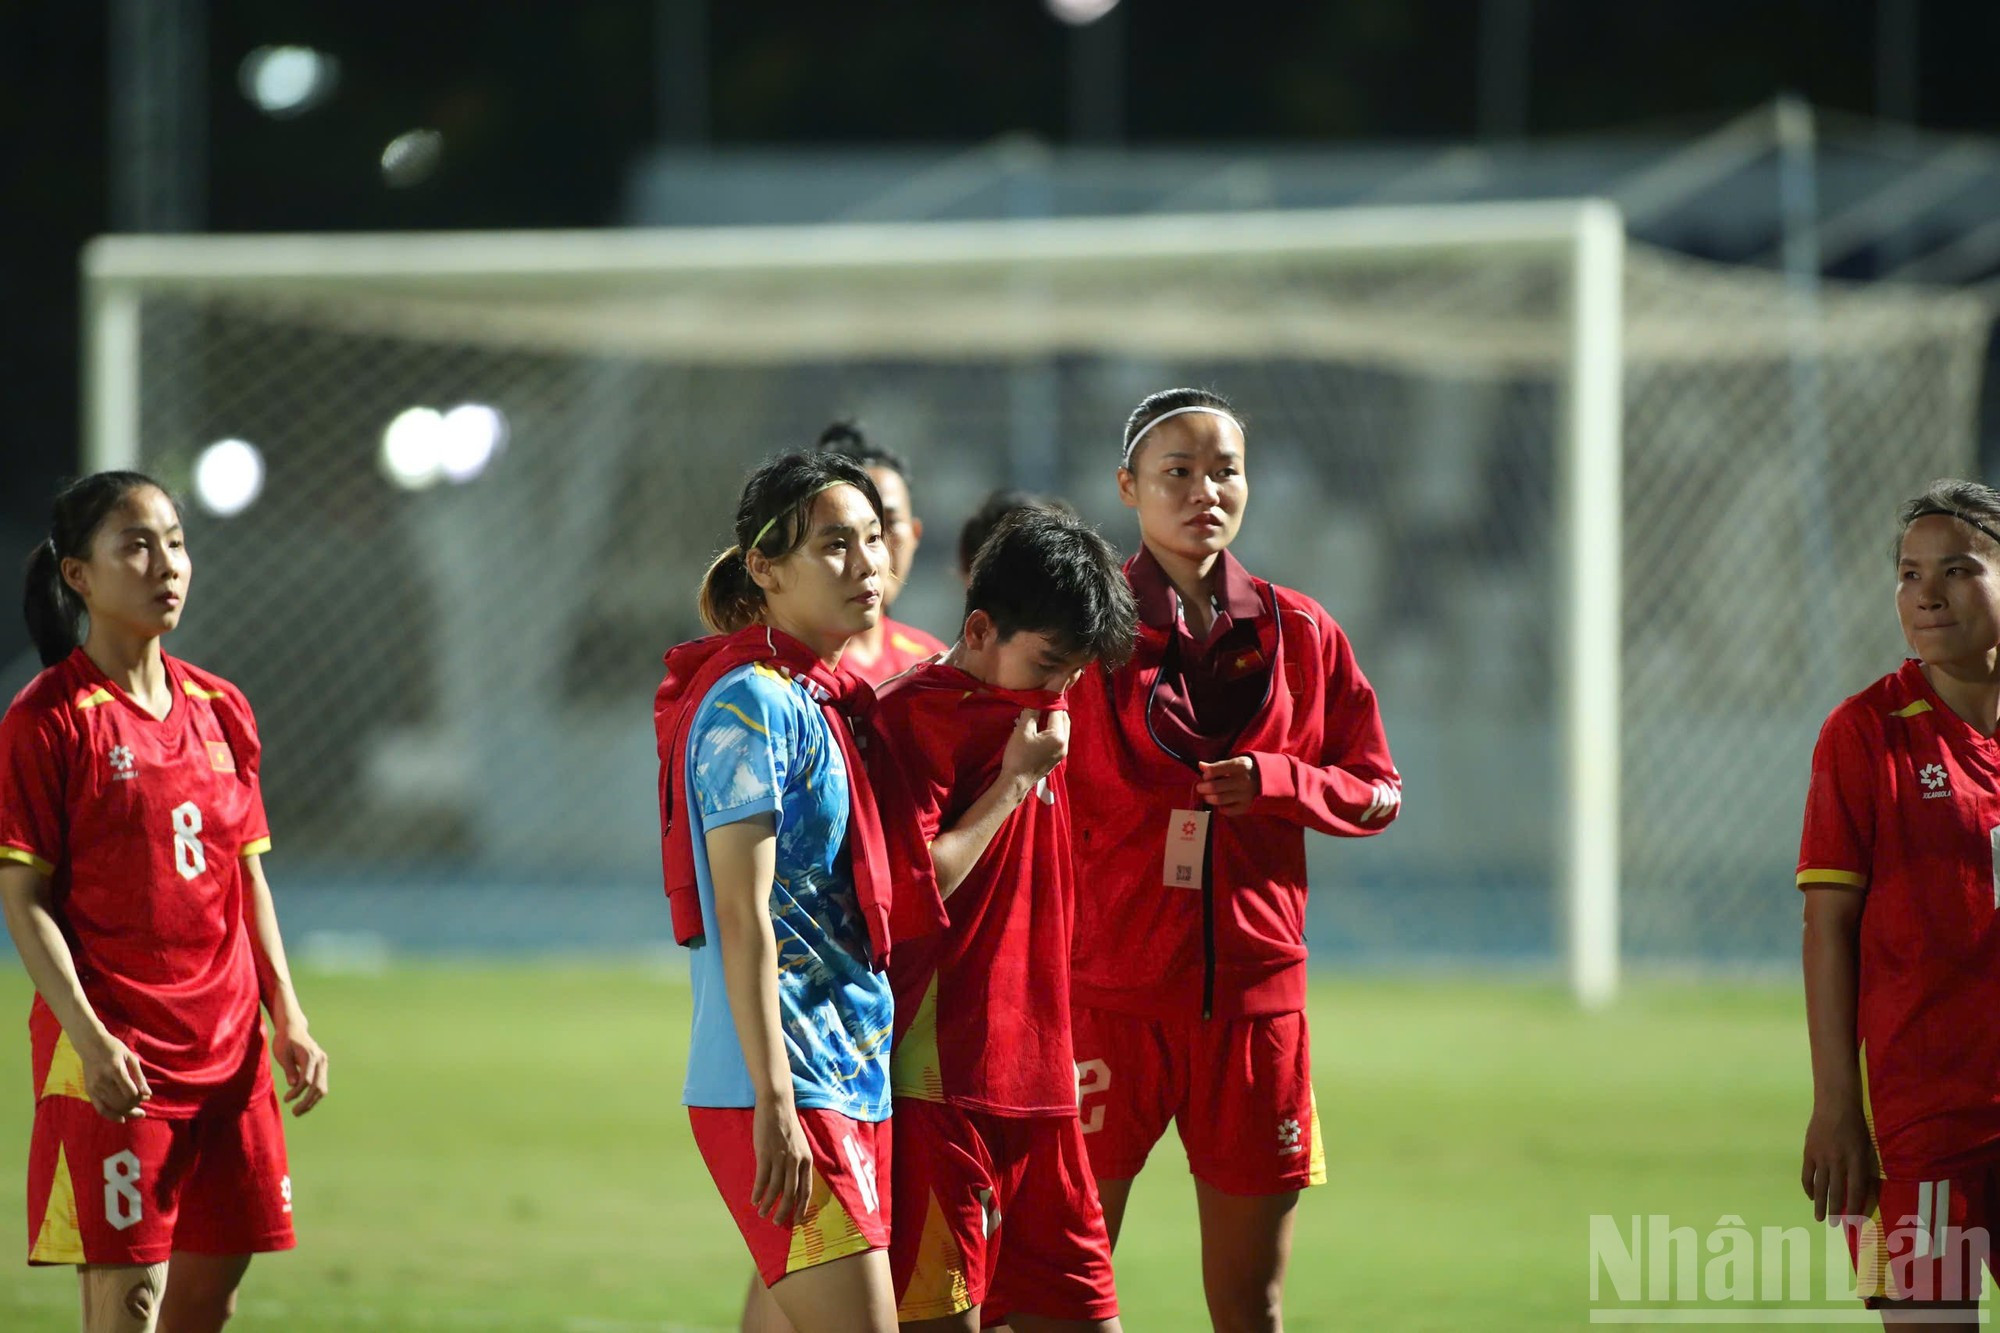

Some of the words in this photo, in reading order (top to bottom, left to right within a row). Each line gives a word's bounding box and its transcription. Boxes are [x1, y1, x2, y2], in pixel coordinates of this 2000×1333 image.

[171, 800, 207, 881] 8
[103, 1148, 143, 1231] 8
[1914, 1179, 1950, 1260] 11
